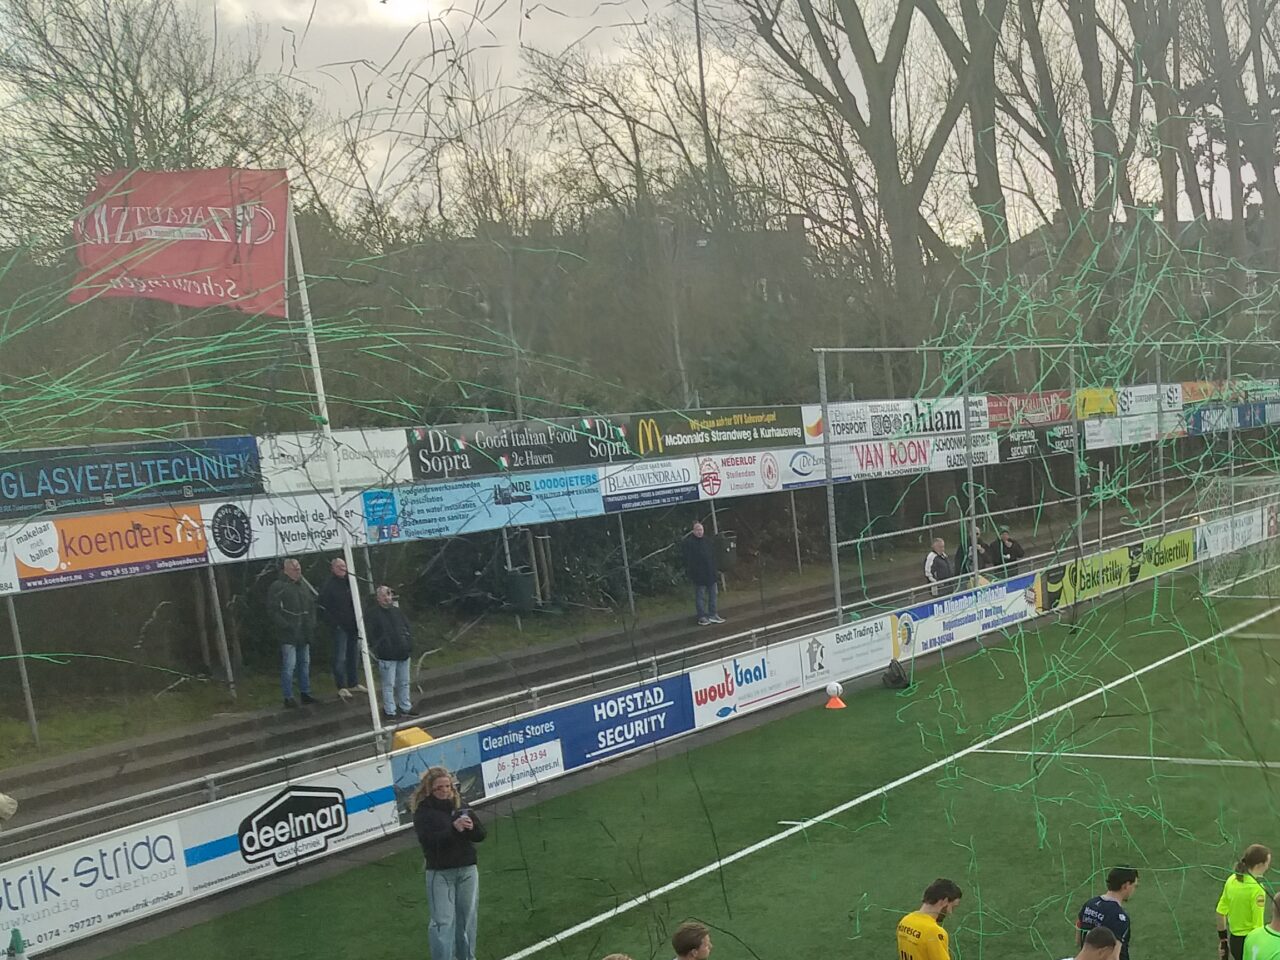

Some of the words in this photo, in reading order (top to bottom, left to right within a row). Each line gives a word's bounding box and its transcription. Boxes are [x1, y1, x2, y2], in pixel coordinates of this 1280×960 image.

[475, 430, 508, 449] Good
[512, 427, 544, 446] Italian
[549, 424, 577, 443] Food
[595, 418, 614, 441] Di
[665, 429, 710, 447] McDonald's
[711, 427, 752, 442] Strandweg
[753, 427, 759, 438] &
[760, 425, 801, 440] Kurhausweg
[832, 421, 868, 436] TOPSPORT
[428, 430, 450, 453] Di
[588, 438, 630, 463] Sopra
[418, 450, 471, 478] Sopra
[526, 451, 554, 465] Haven
[721, 455, 757, 468] NEDERLOF
[1, 454, 251, 499] GLASVEZELTECHNIEK
[534, 473, 598, 491] LOODGIETERS
[608, 468, 691, 493] BLAAUWENDRAAD
[16, 522, 50, 545] makelaar
[61, 523, 174, 558] koenders
[29, 545, 54, 563] ballen
[1154, 539, 1190, 567] bakertilly
[836, 628, 853, 644] Bondt
[853, 624, 874, 639] Trading
[593, 686, 665, 722] HOFSTAD
[482, 729, 525, 752] Cleaning
[525, 720, 555, 739] Stores
[597, 712, 667, 749] SECURITY
[242, 804, 344, 852] deelman
[0, 833, 175, 913] trik-Strida
[95, 865, 177, 901] Onderhoud
[37, 929, 61, 944] 0174
[69, 915, 103, 933] 297273
